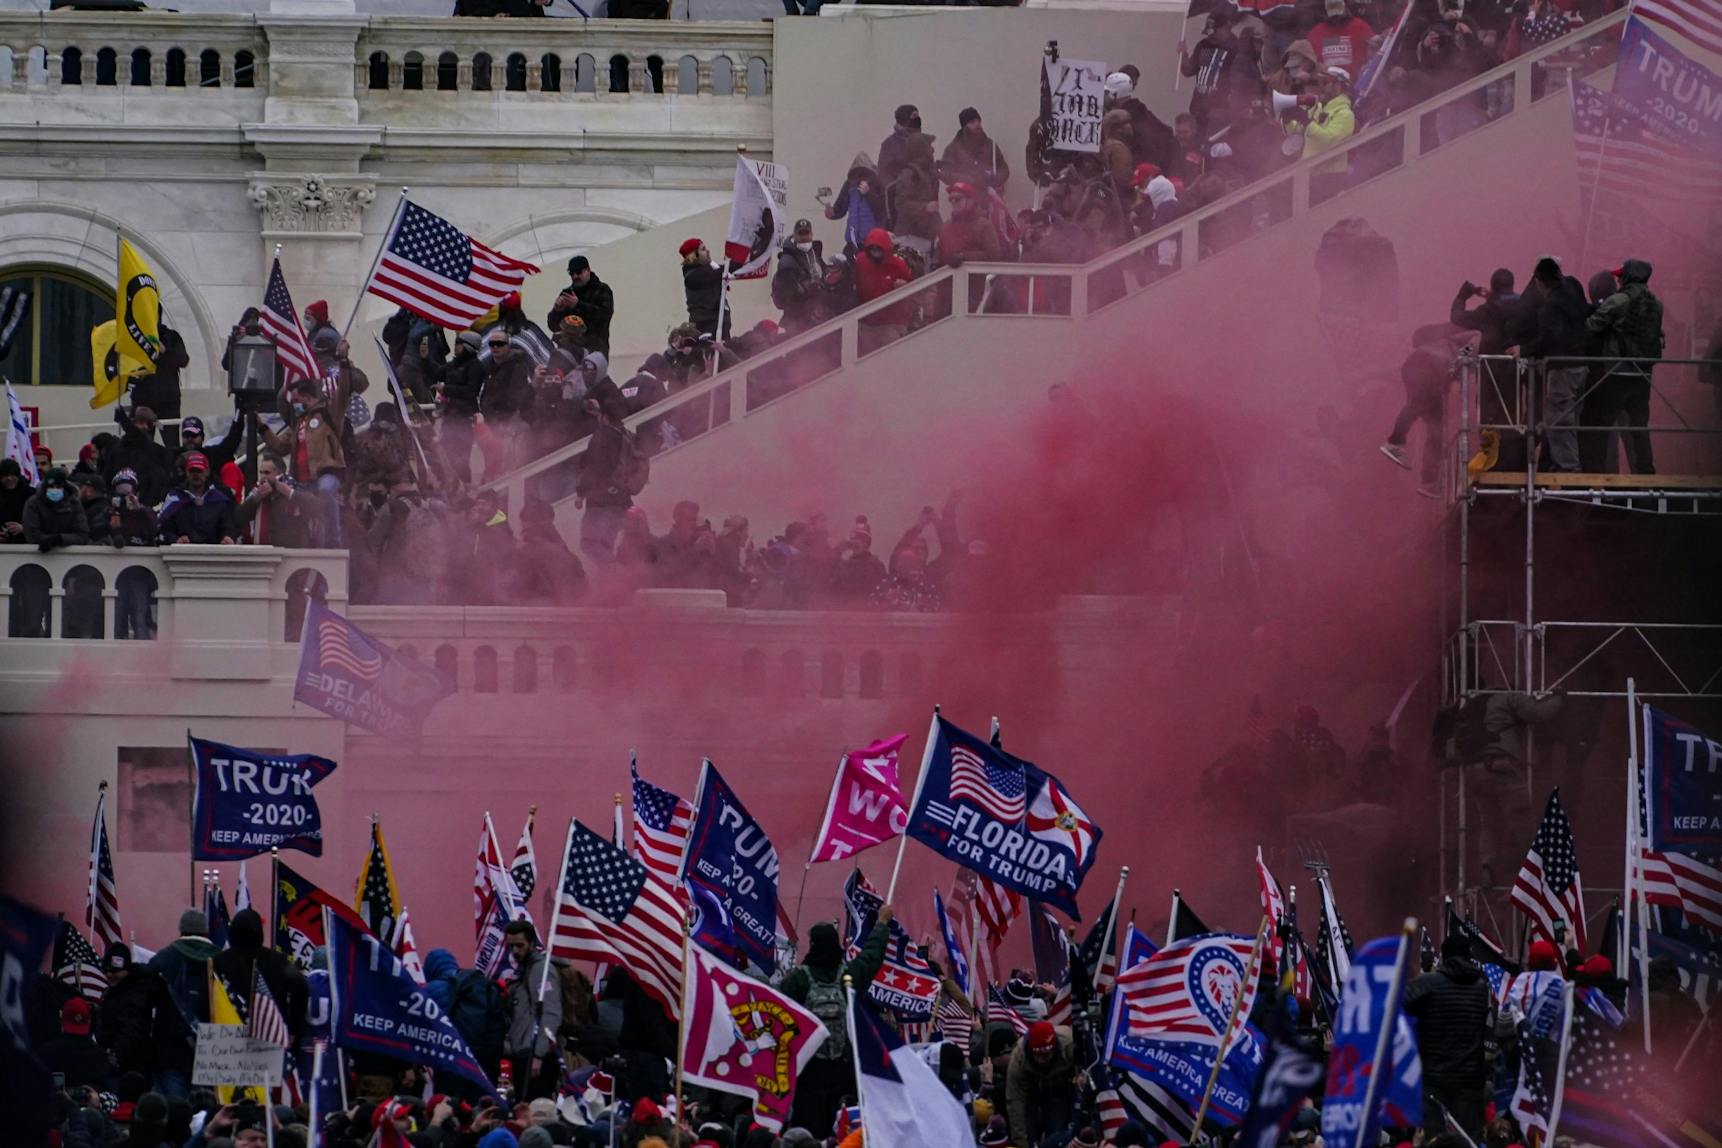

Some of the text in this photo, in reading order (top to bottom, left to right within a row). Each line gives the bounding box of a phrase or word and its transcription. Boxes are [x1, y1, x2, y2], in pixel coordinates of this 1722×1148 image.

[1638, 40, 1722, 121] TRUM
[324, 697, 355, 719] FOR
[242, 803, 313, 826] -2020-
[1673, 816, 1708, 830] KEEP
[211, 830, 240, 843] KEEP
[951, 804, 1069, 882] FLORIDA
[697, 857, 722, 879] KEEP
[947, 834, 1058, 893] FOR TRUMP
[733, 905, 776, 945] GREAT!
[867, 983, 932, 1014] AMERICA
[353, 1013, 394, 1031] KEEP
[396, 1023, 463, 1053] AMERICA
[1145, 1046, 1213, 1088] AMERICA
